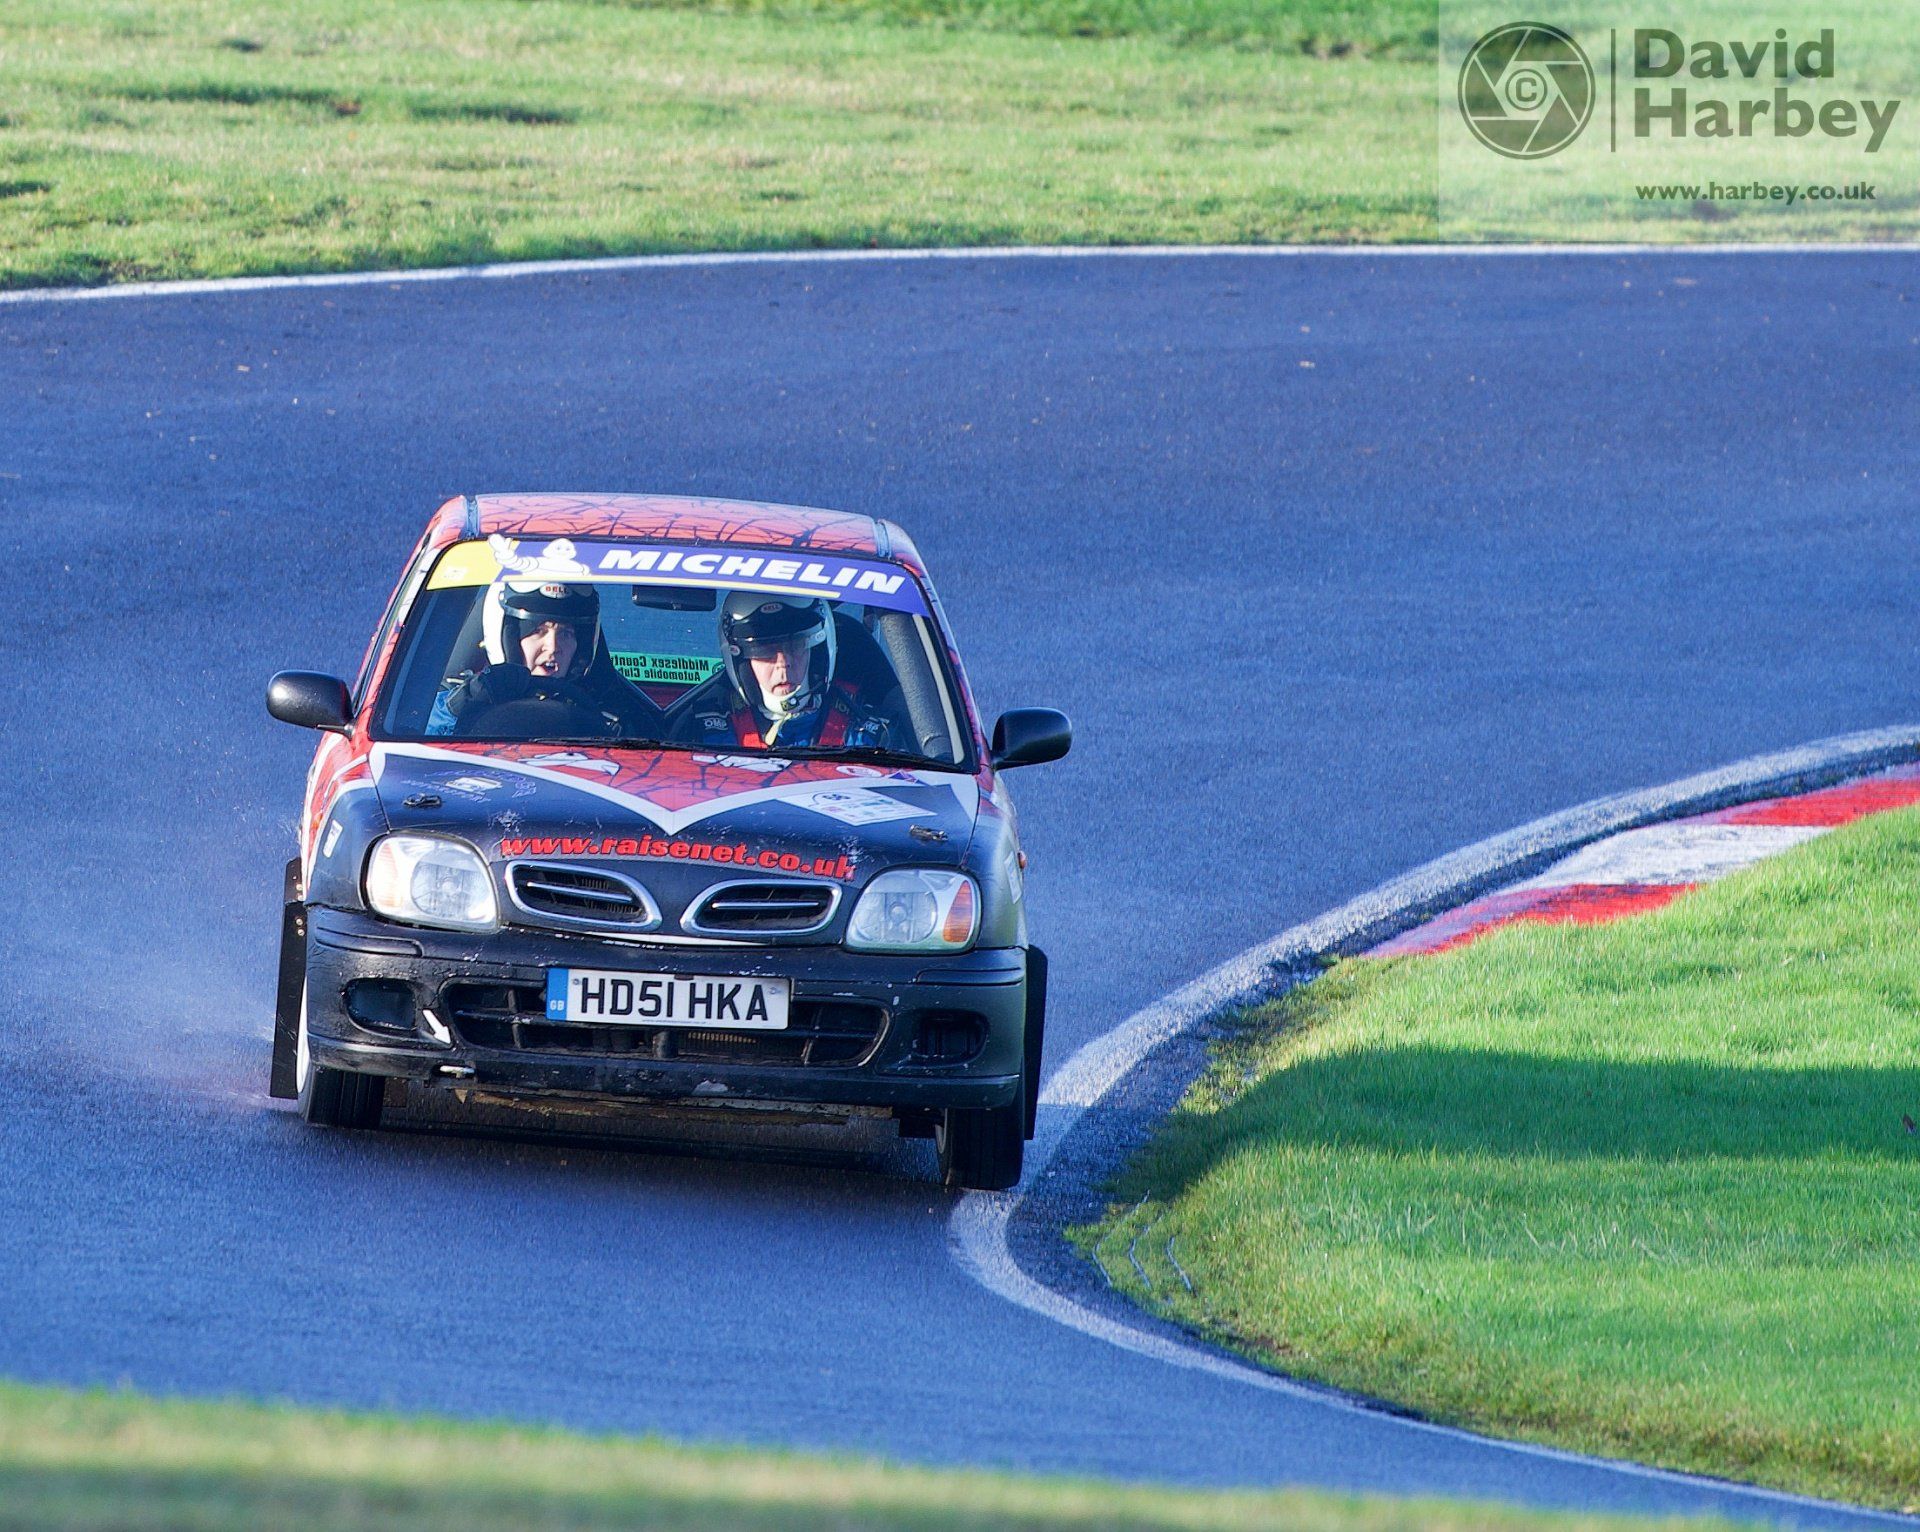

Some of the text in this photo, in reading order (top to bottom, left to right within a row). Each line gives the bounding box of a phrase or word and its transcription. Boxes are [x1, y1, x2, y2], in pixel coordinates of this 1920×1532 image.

[599, 549, 905, 594] MICHELIN
[500, 835, 855, 882] www.raisenet.co.uk
[549, 1000, 564, 1012] GB
[581, 977, 769, 1021] HD51 HKA
